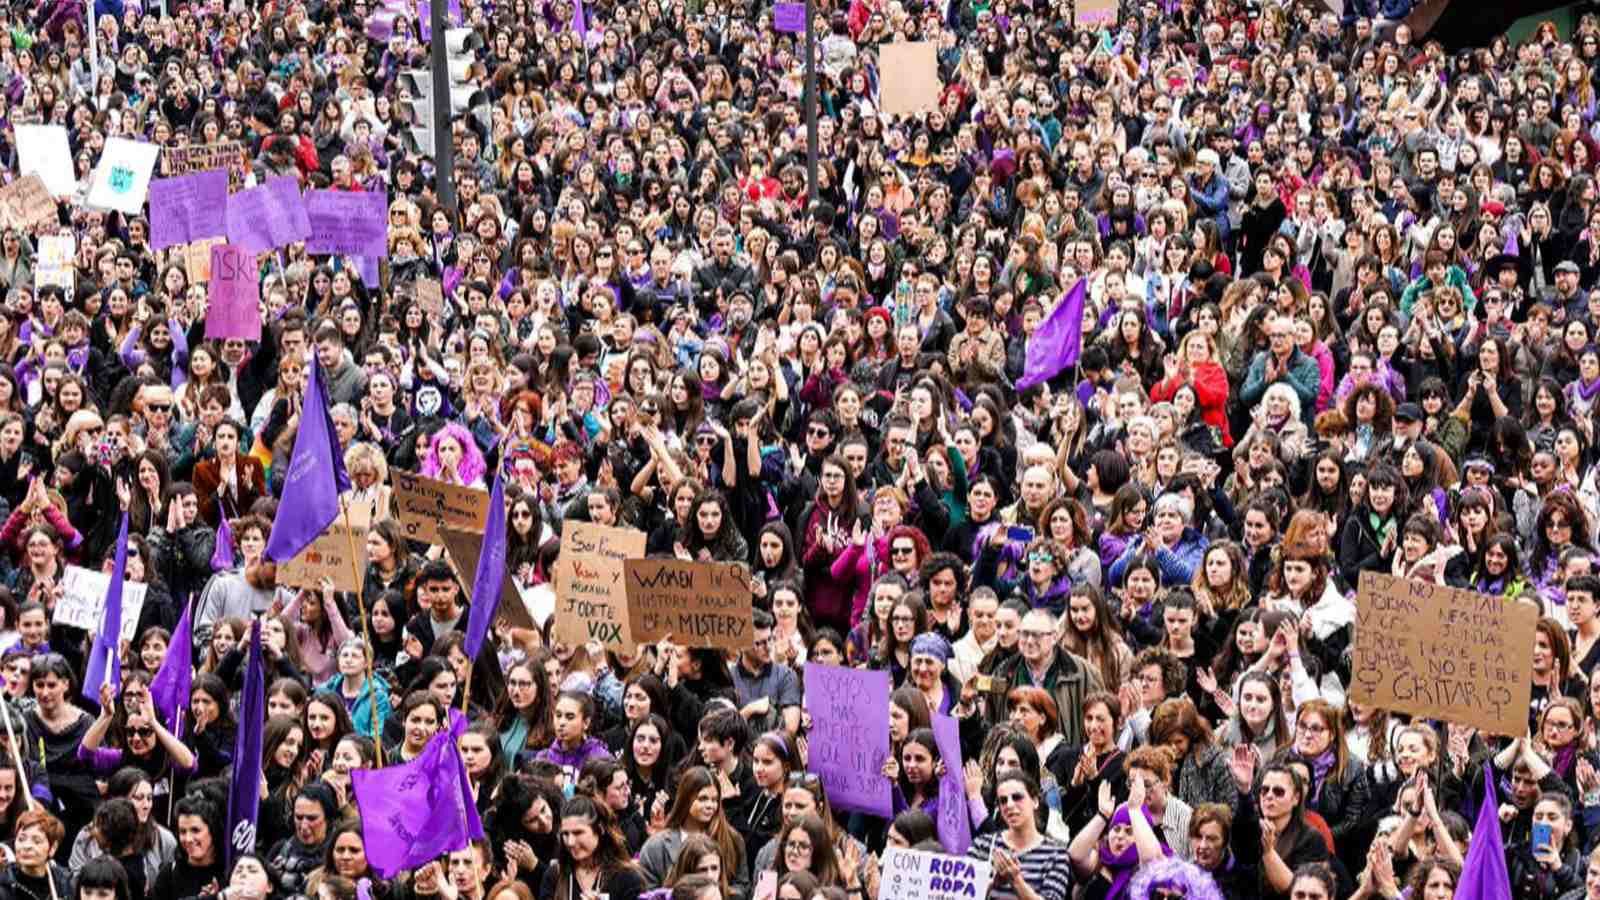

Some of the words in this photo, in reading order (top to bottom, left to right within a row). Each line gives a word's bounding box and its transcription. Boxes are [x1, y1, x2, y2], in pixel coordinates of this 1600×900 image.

[633, 565, 693, 589] WOMEN
[1409, 582, 1435, 599] NO
[587, 620, 623, 644] VOX
[679, 612, 746, 638] MISTERY
[1428, 659, 1456, 676] NO
[1392, 671, 1482, 709] GRITAR
[893, 852, 921, 872] CON
[930, 857, 976, 880] ROPA
[930, 875, 977, 898] ROPA
